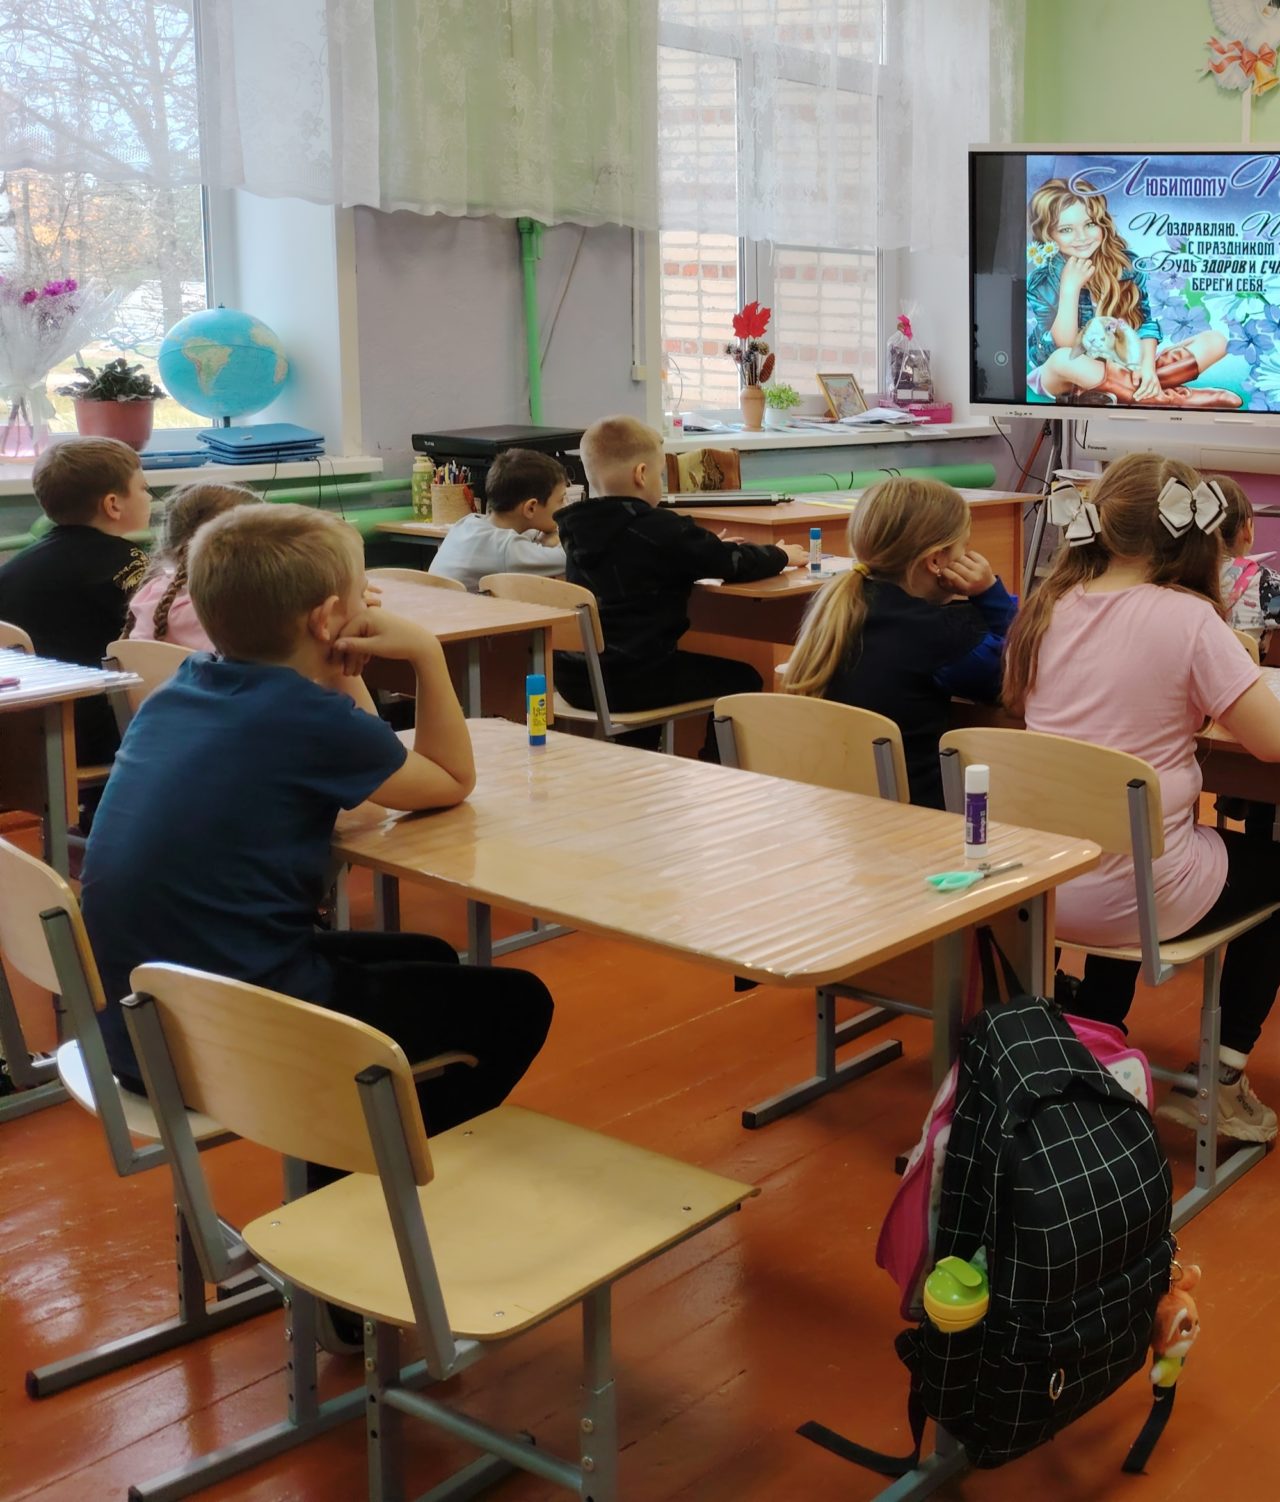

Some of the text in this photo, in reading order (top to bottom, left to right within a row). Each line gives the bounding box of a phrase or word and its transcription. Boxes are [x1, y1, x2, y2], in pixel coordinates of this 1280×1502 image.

[1187, 241, 1195, 255] С
[1197, 241, 1275, 256] ПРАЗДНИКОМ
[1133, 250, 1198, 273] БУДЬ
[1201, 260, 1246, 274] ЗДОРОВ
[1192, 278, 1233, 292] БЕРЕГИ
